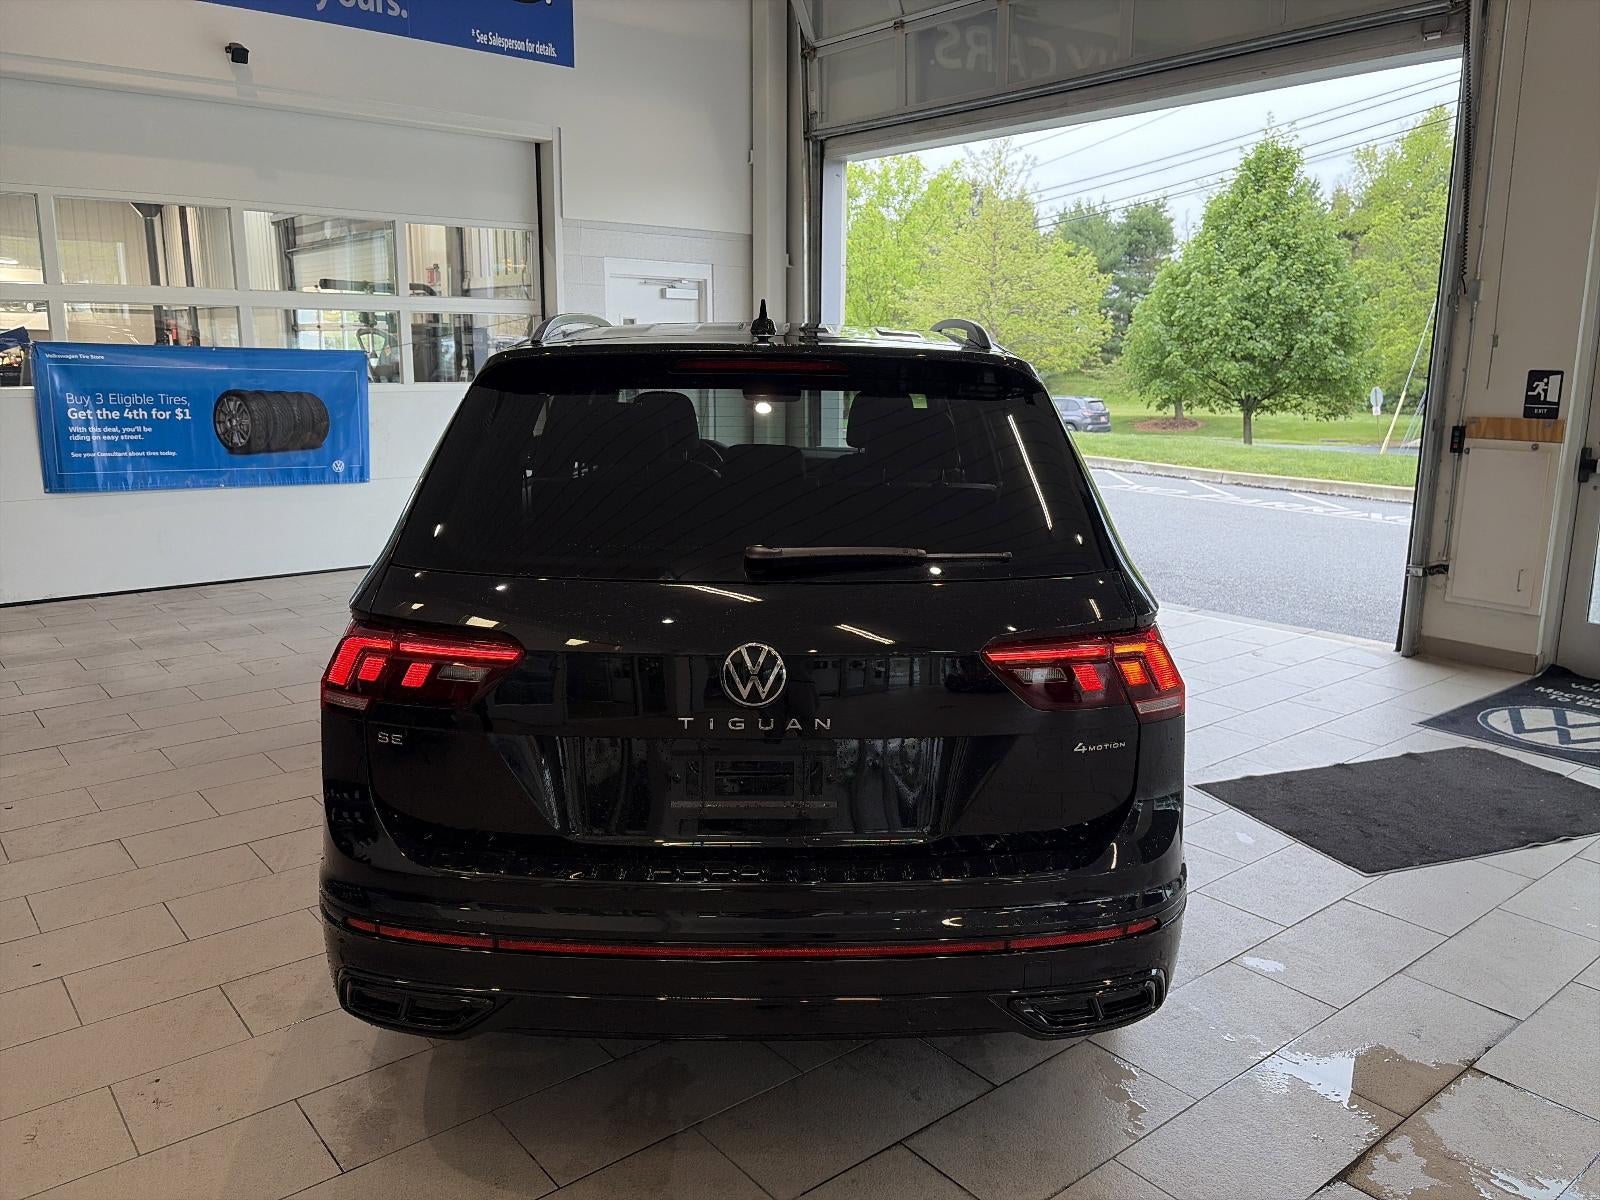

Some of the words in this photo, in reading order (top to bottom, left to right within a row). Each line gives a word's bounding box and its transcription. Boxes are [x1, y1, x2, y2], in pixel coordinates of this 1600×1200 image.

[488, 31, 525, 51] Salesperson
[525, 38, 535, 52] for
[535, 41, 557, 57] details.
[66, 393, 90, 407] Buy
[95, 393, 104, 405] 3
[108, 393, 154, 407] Eligible
[157, 393, 191, 407] Tires,
[67, 408, 93, 420] Get
[96, 408, 120, 420] the
[123, 408, 148, 420] 4th
[151, 408, 171, 420] for
[175, 407, 192, 421] $1
[88, 425, 101, 433] this
[102, 425, 121, 434] deal,
[122, 425, 142, 434] you'll
[143, 425, 153, 433] be
[69, 434, 91, 442] riding
[677, 717, 832, 730] TIGUAN
[377, 731, 403, 745] SE
[1073, 742, 1126, 754] 4MOTION
